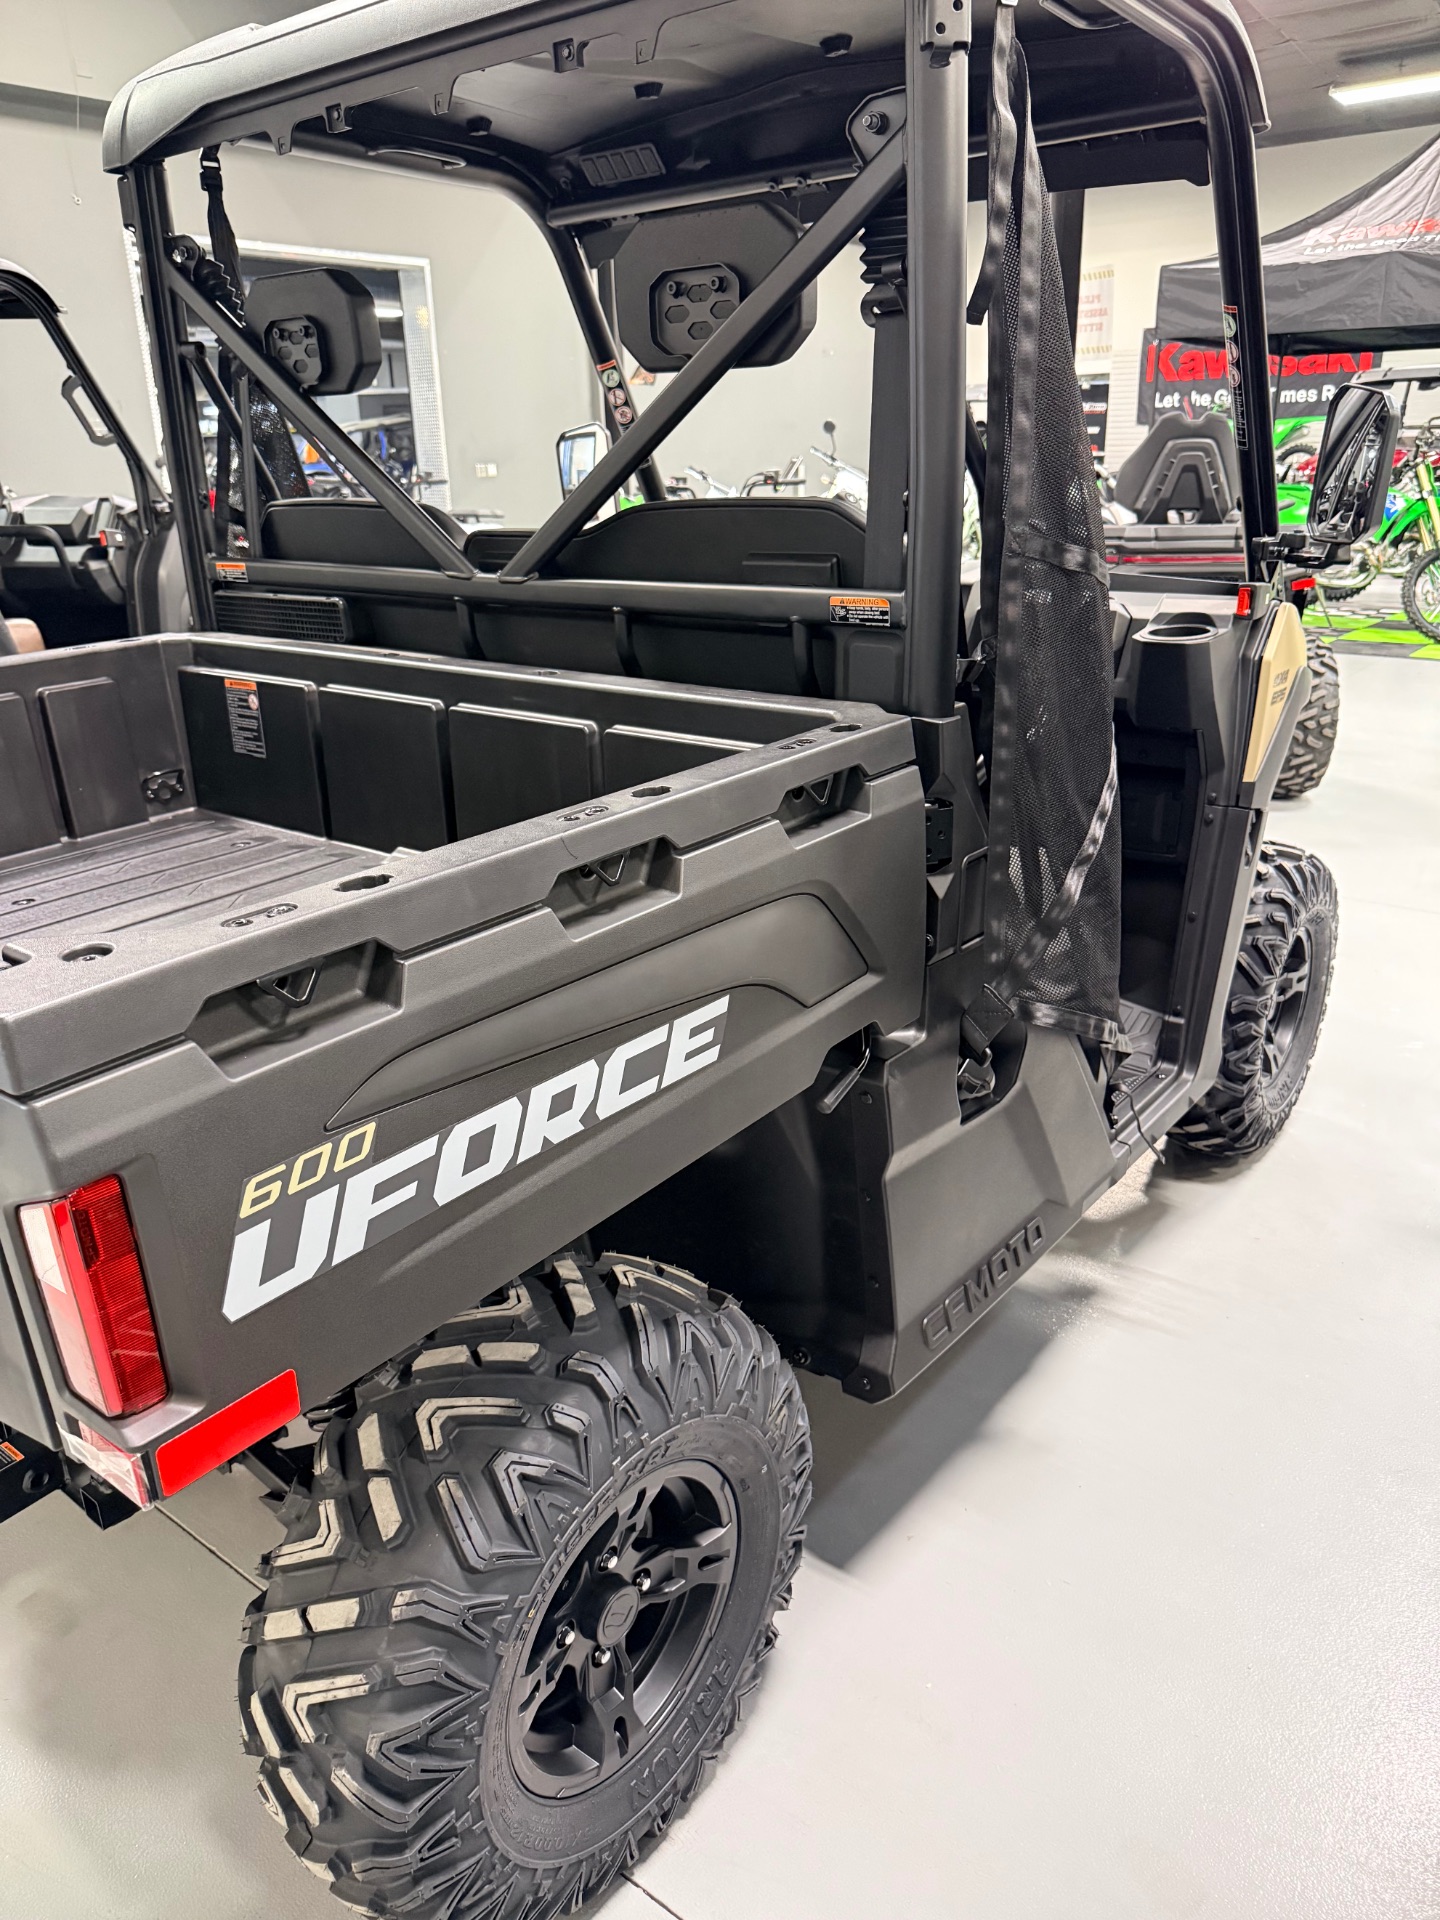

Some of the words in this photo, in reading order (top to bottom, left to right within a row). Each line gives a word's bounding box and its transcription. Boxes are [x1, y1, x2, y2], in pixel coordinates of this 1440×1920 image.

[1155, 391, 1181, 408] Let
[845, 598, 880, 606] WARNING
[222, 994, 730, 1324] UFORCE
[240, 1121, 376, 1219] 600
[922, 1216, 1047, 1350] CFMOTO
